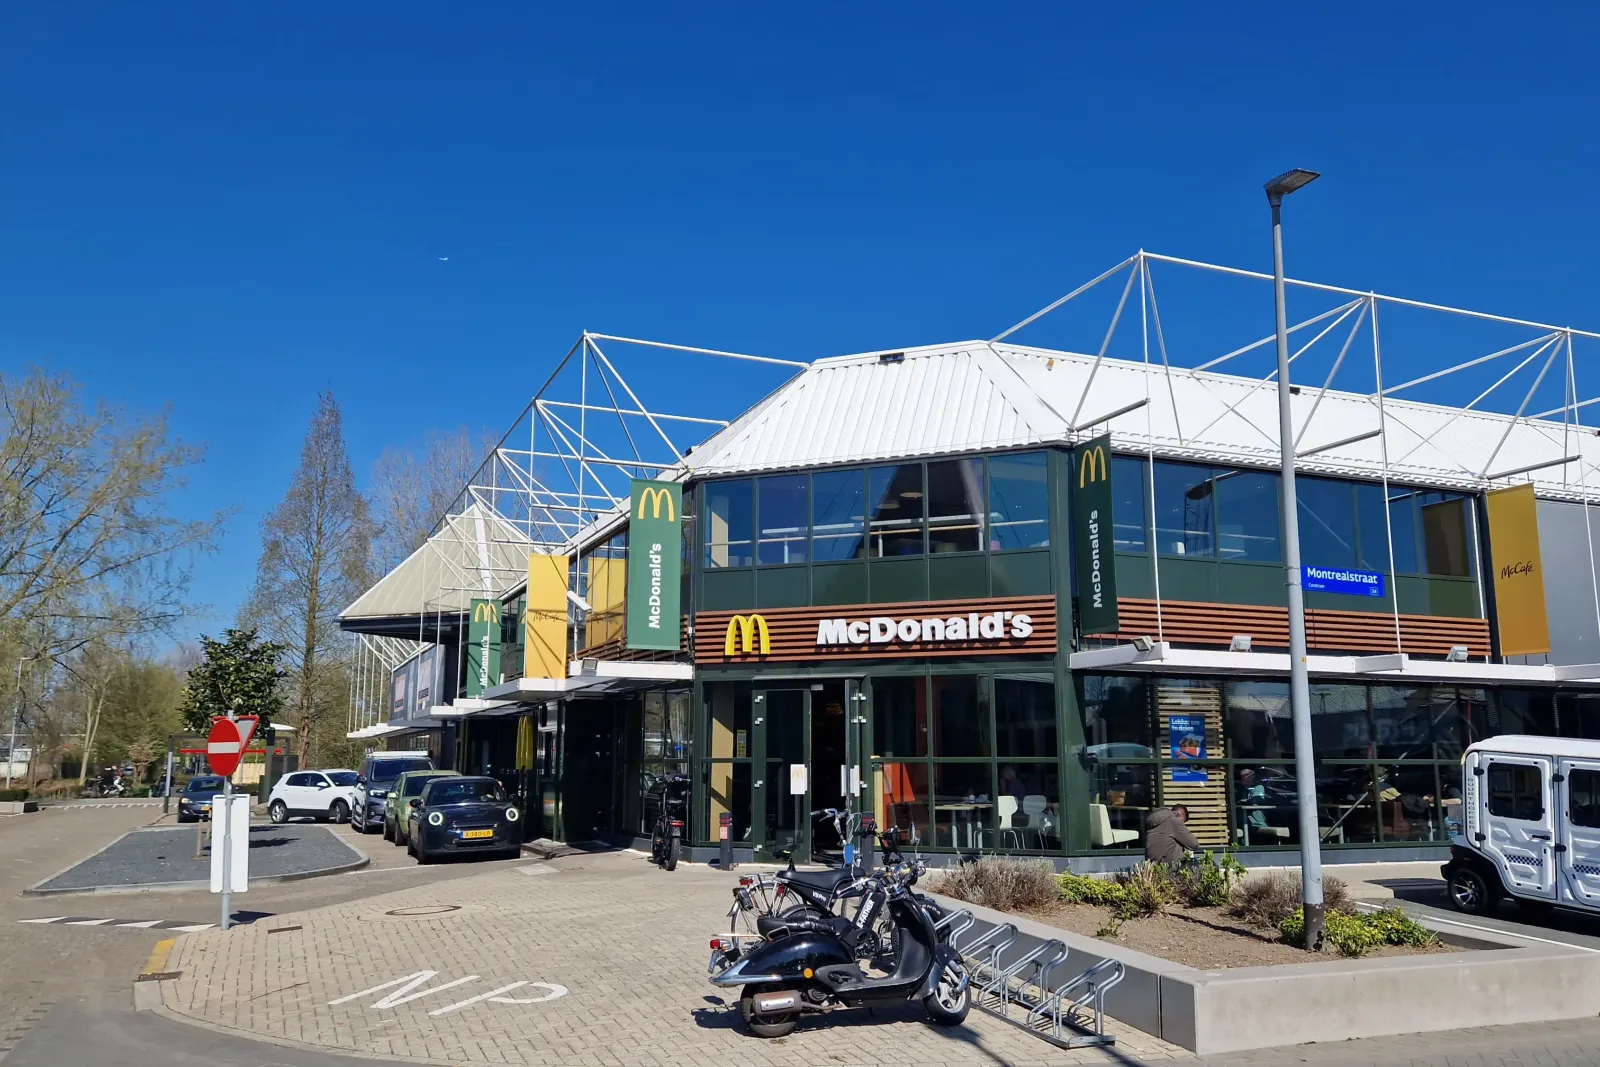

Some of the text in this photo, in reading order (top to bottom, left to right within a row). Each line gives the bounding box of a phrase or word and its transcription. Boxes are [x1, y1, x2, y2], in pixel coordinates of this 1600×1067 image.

[1089, 509, 1103, 608] McDonald's
[1307, 567, 1378, 584] Montrealstraat
[1501, 560, 1534, 579] McCafé
[648, 543, 662, 629] McDonald's
[816, 611, 1034, 645] McDonald's
